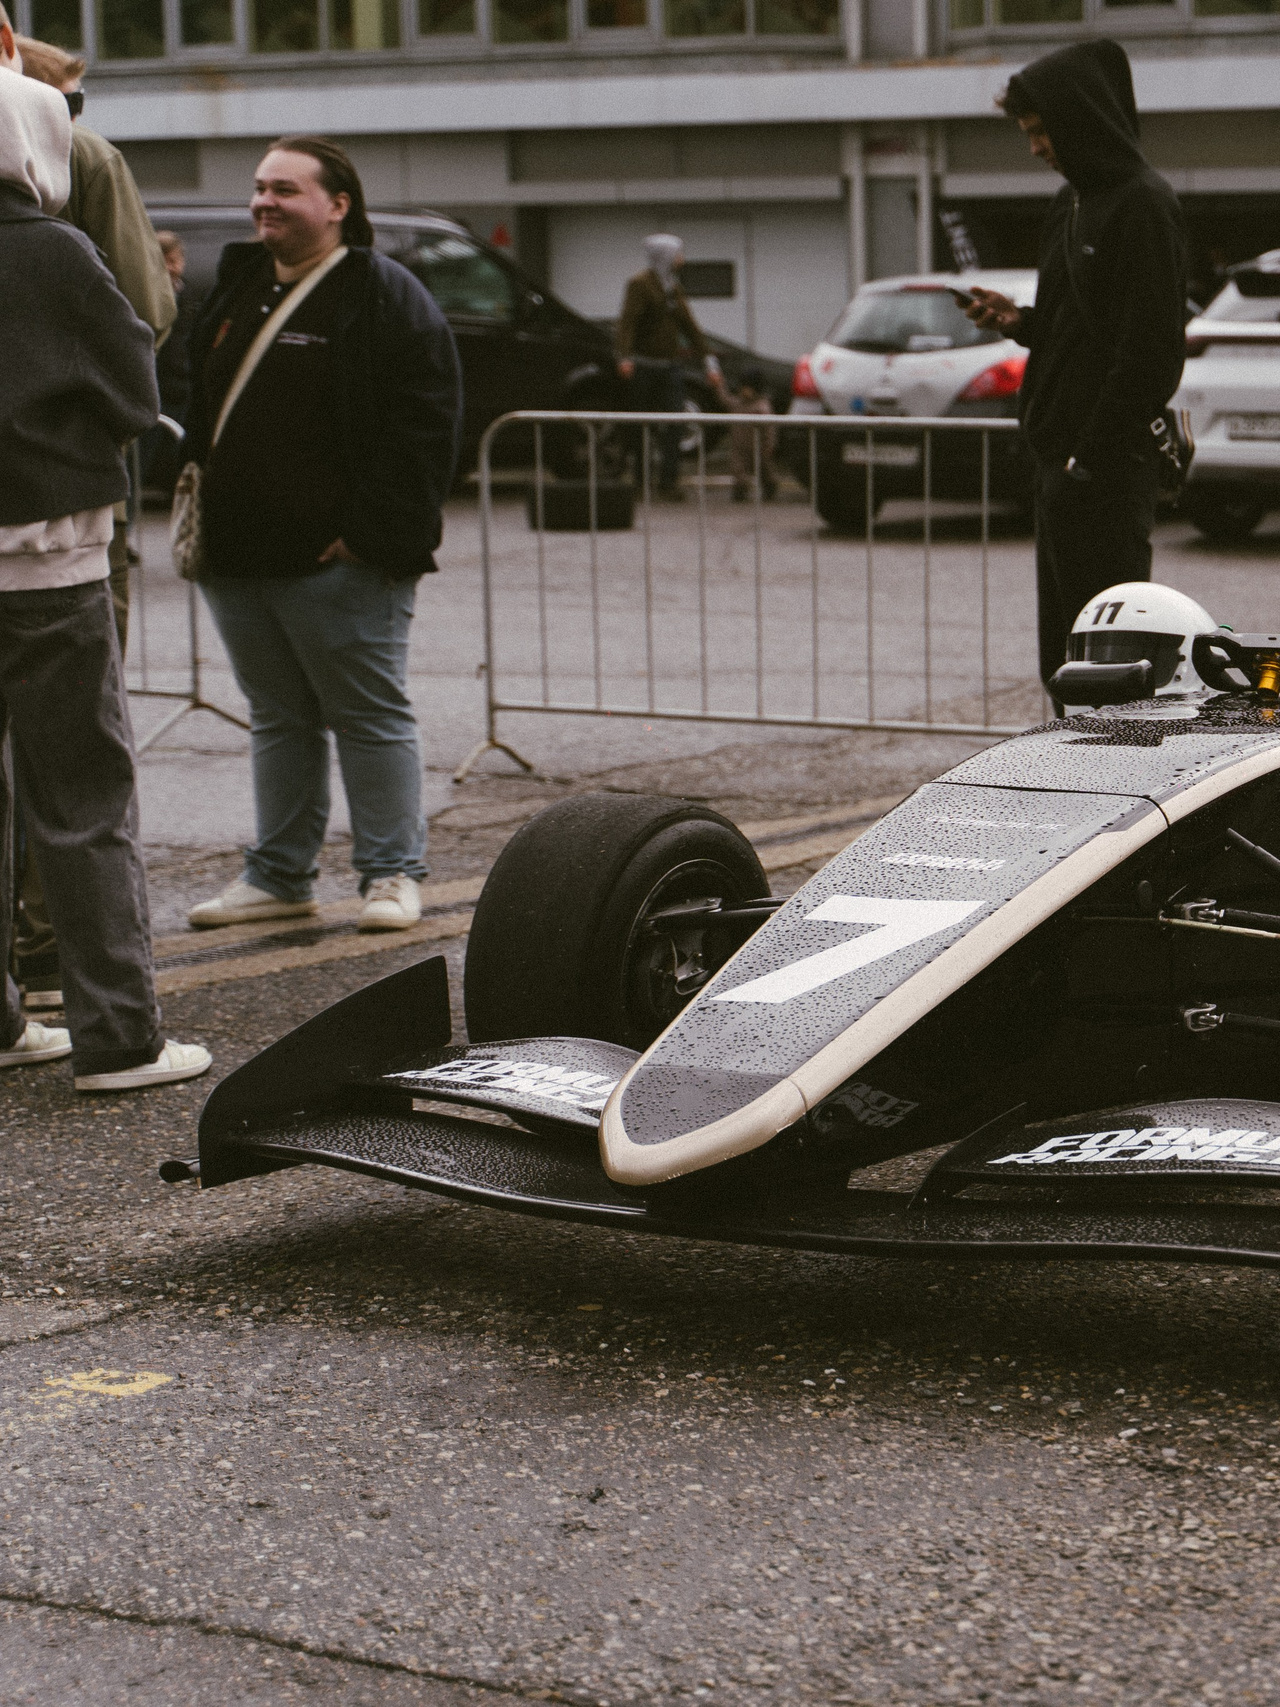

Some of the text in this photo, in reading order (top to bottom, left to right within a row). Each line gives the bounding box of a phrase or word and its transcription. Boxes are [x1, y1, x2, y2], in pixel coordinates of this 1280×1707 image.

[1092, 601, 1125, 626] 11
[707, 893, 988, 1004] 7
[381, 1070, 608, 1110] RACING.
[424, 1059, 619, 1096] FORMU
